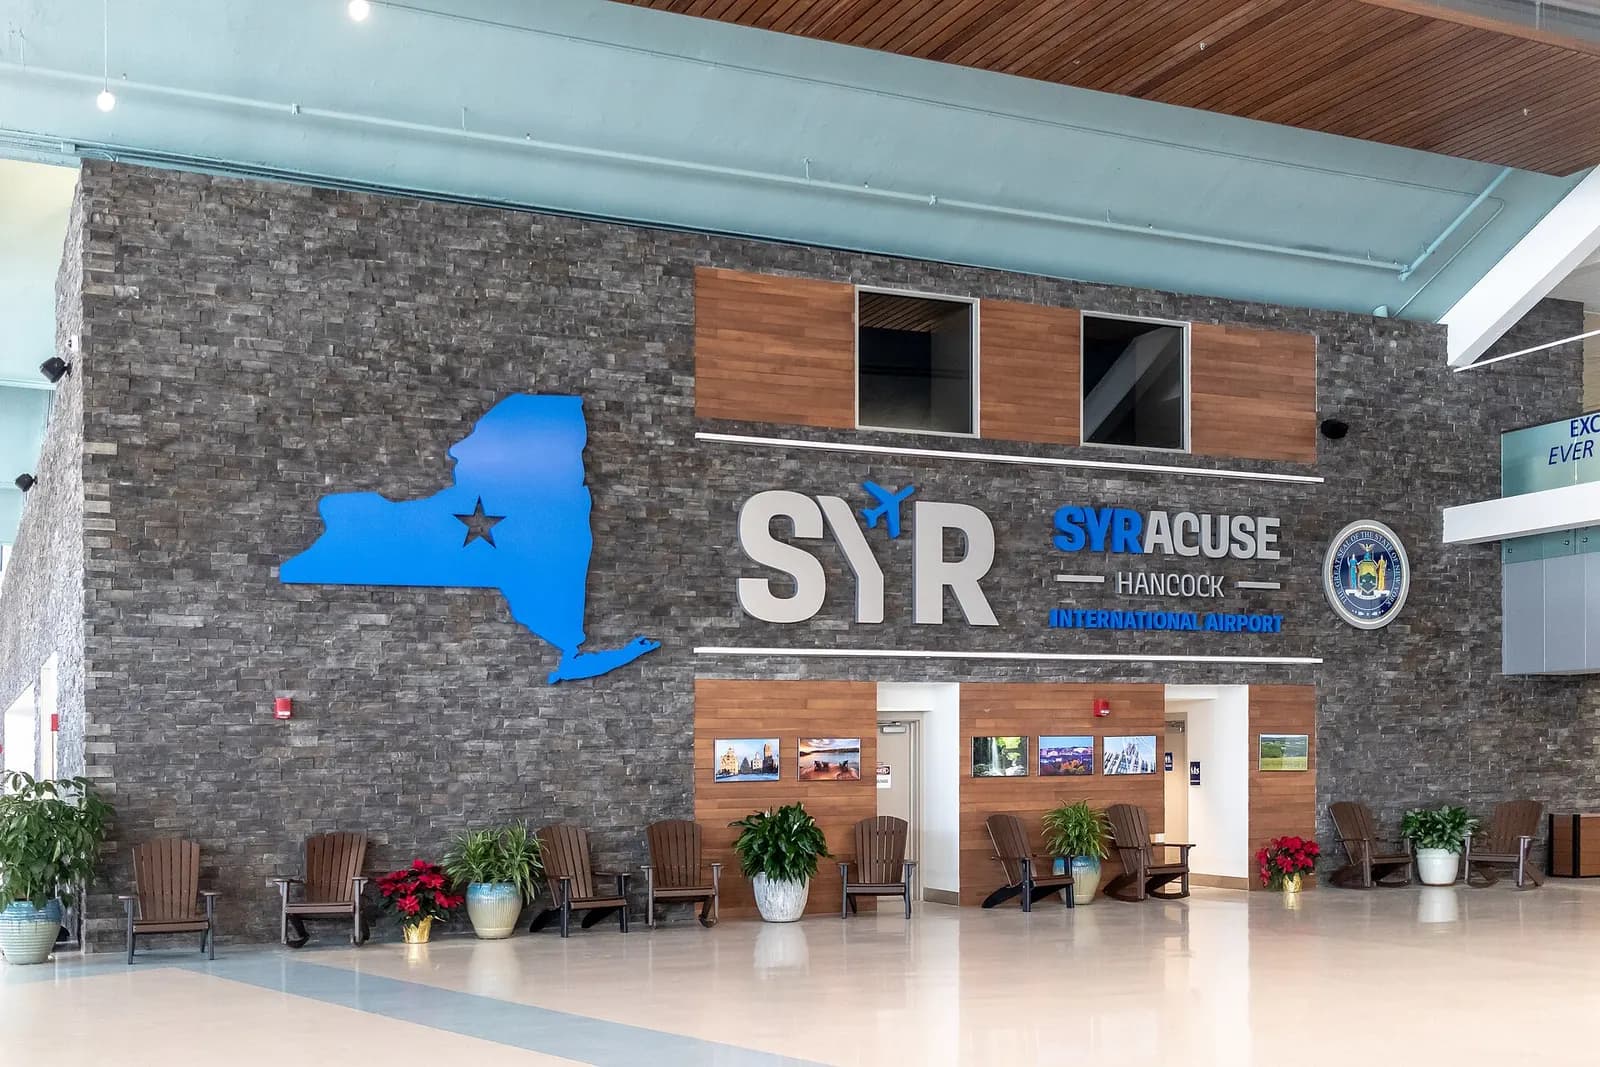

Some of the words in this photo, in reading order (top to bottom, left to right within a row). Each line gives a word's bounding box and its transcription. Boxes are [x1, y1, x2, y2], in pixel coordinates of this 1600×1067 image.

[1570, 414, 1600, 438] EXC
[1548, 440, 1594, 465] EVER
[1053, 505, 1281, 560] SYRACUSE
[736, 488, 999, 626] SYR
[1333, 559, 1341, 587] GREAT
[1337, 540, 1351, 558] SEAL
[1350, 533, 1360, 542] OF
[1360, 531, 1374, 539] THE
[1374, 533, 1393, 553] STATE
[1115, 571, 1225, 598] HANCOCK
[1048, 608, 1201, 632] INTERNATIONAL
[1202, 613, 1284, 634] AIRPORT
